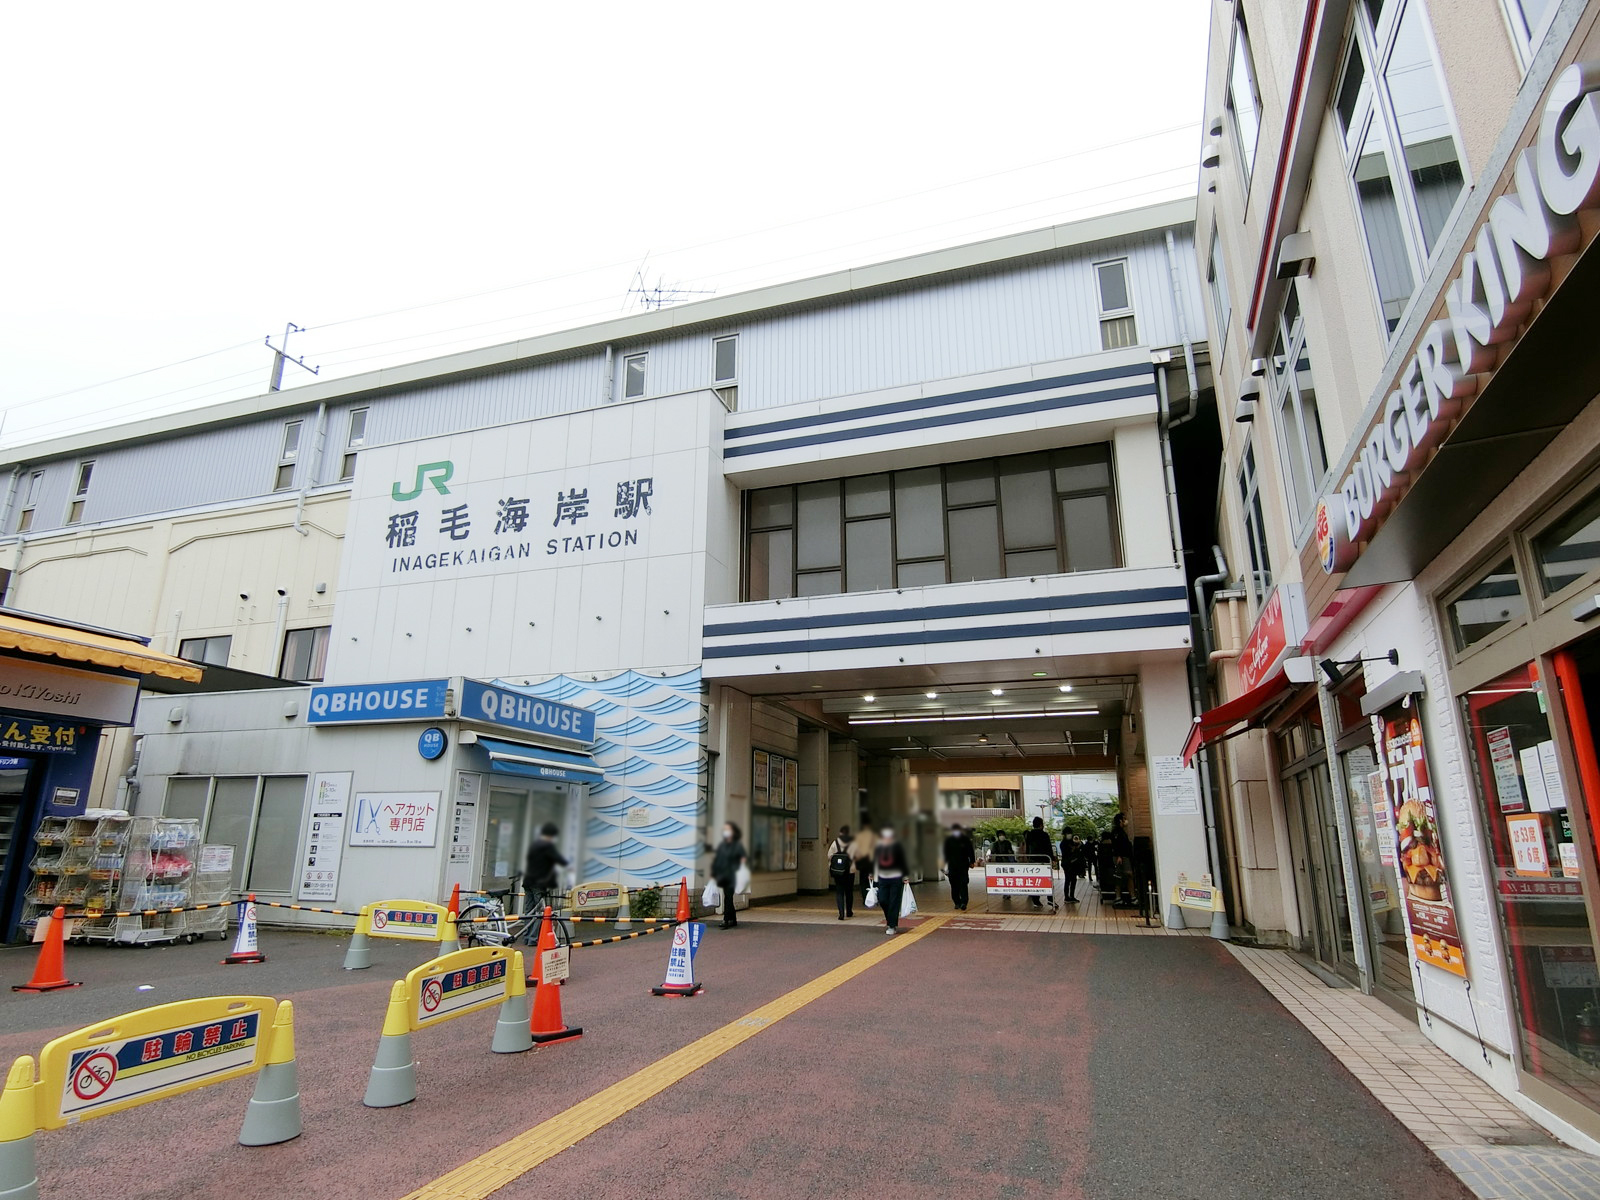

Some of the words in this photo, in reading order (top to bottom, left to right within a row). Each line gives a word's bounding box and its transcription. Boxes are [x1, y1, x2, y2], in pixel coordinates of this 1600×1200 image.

[1341, 319, 1453, 541] BURGER
[1445, 62, 1600, 376] KING
[391, 460, 454, 502] JR
[385, 477, 654, 549] 稲毛海岸駅
[392, 542, 531, 573] INAGEKAIGAN
[546, 529, 639, 556] STATION
[312, 688, 429, 716] QBHOUSE
[481, 690, 583, 734] QBHOUSE
[0, 722, 75, 746] ん受付
[424, 733, 440, 743] QB
[540, 767, 566, 778] QBHOUSE
[383, 803, 435, 816] ヘアカット
[389, 817, 426, 832] 専門店
[452, 964, 502, 988] 駐輪禁止
[141, 1019, 248, 1062] 駐輪禁止
[186, 1053, 196, 1061] NO
[197, 1046, 222, 1058] BICYCLES
[222, 1041, 246, 1052] PARKING
